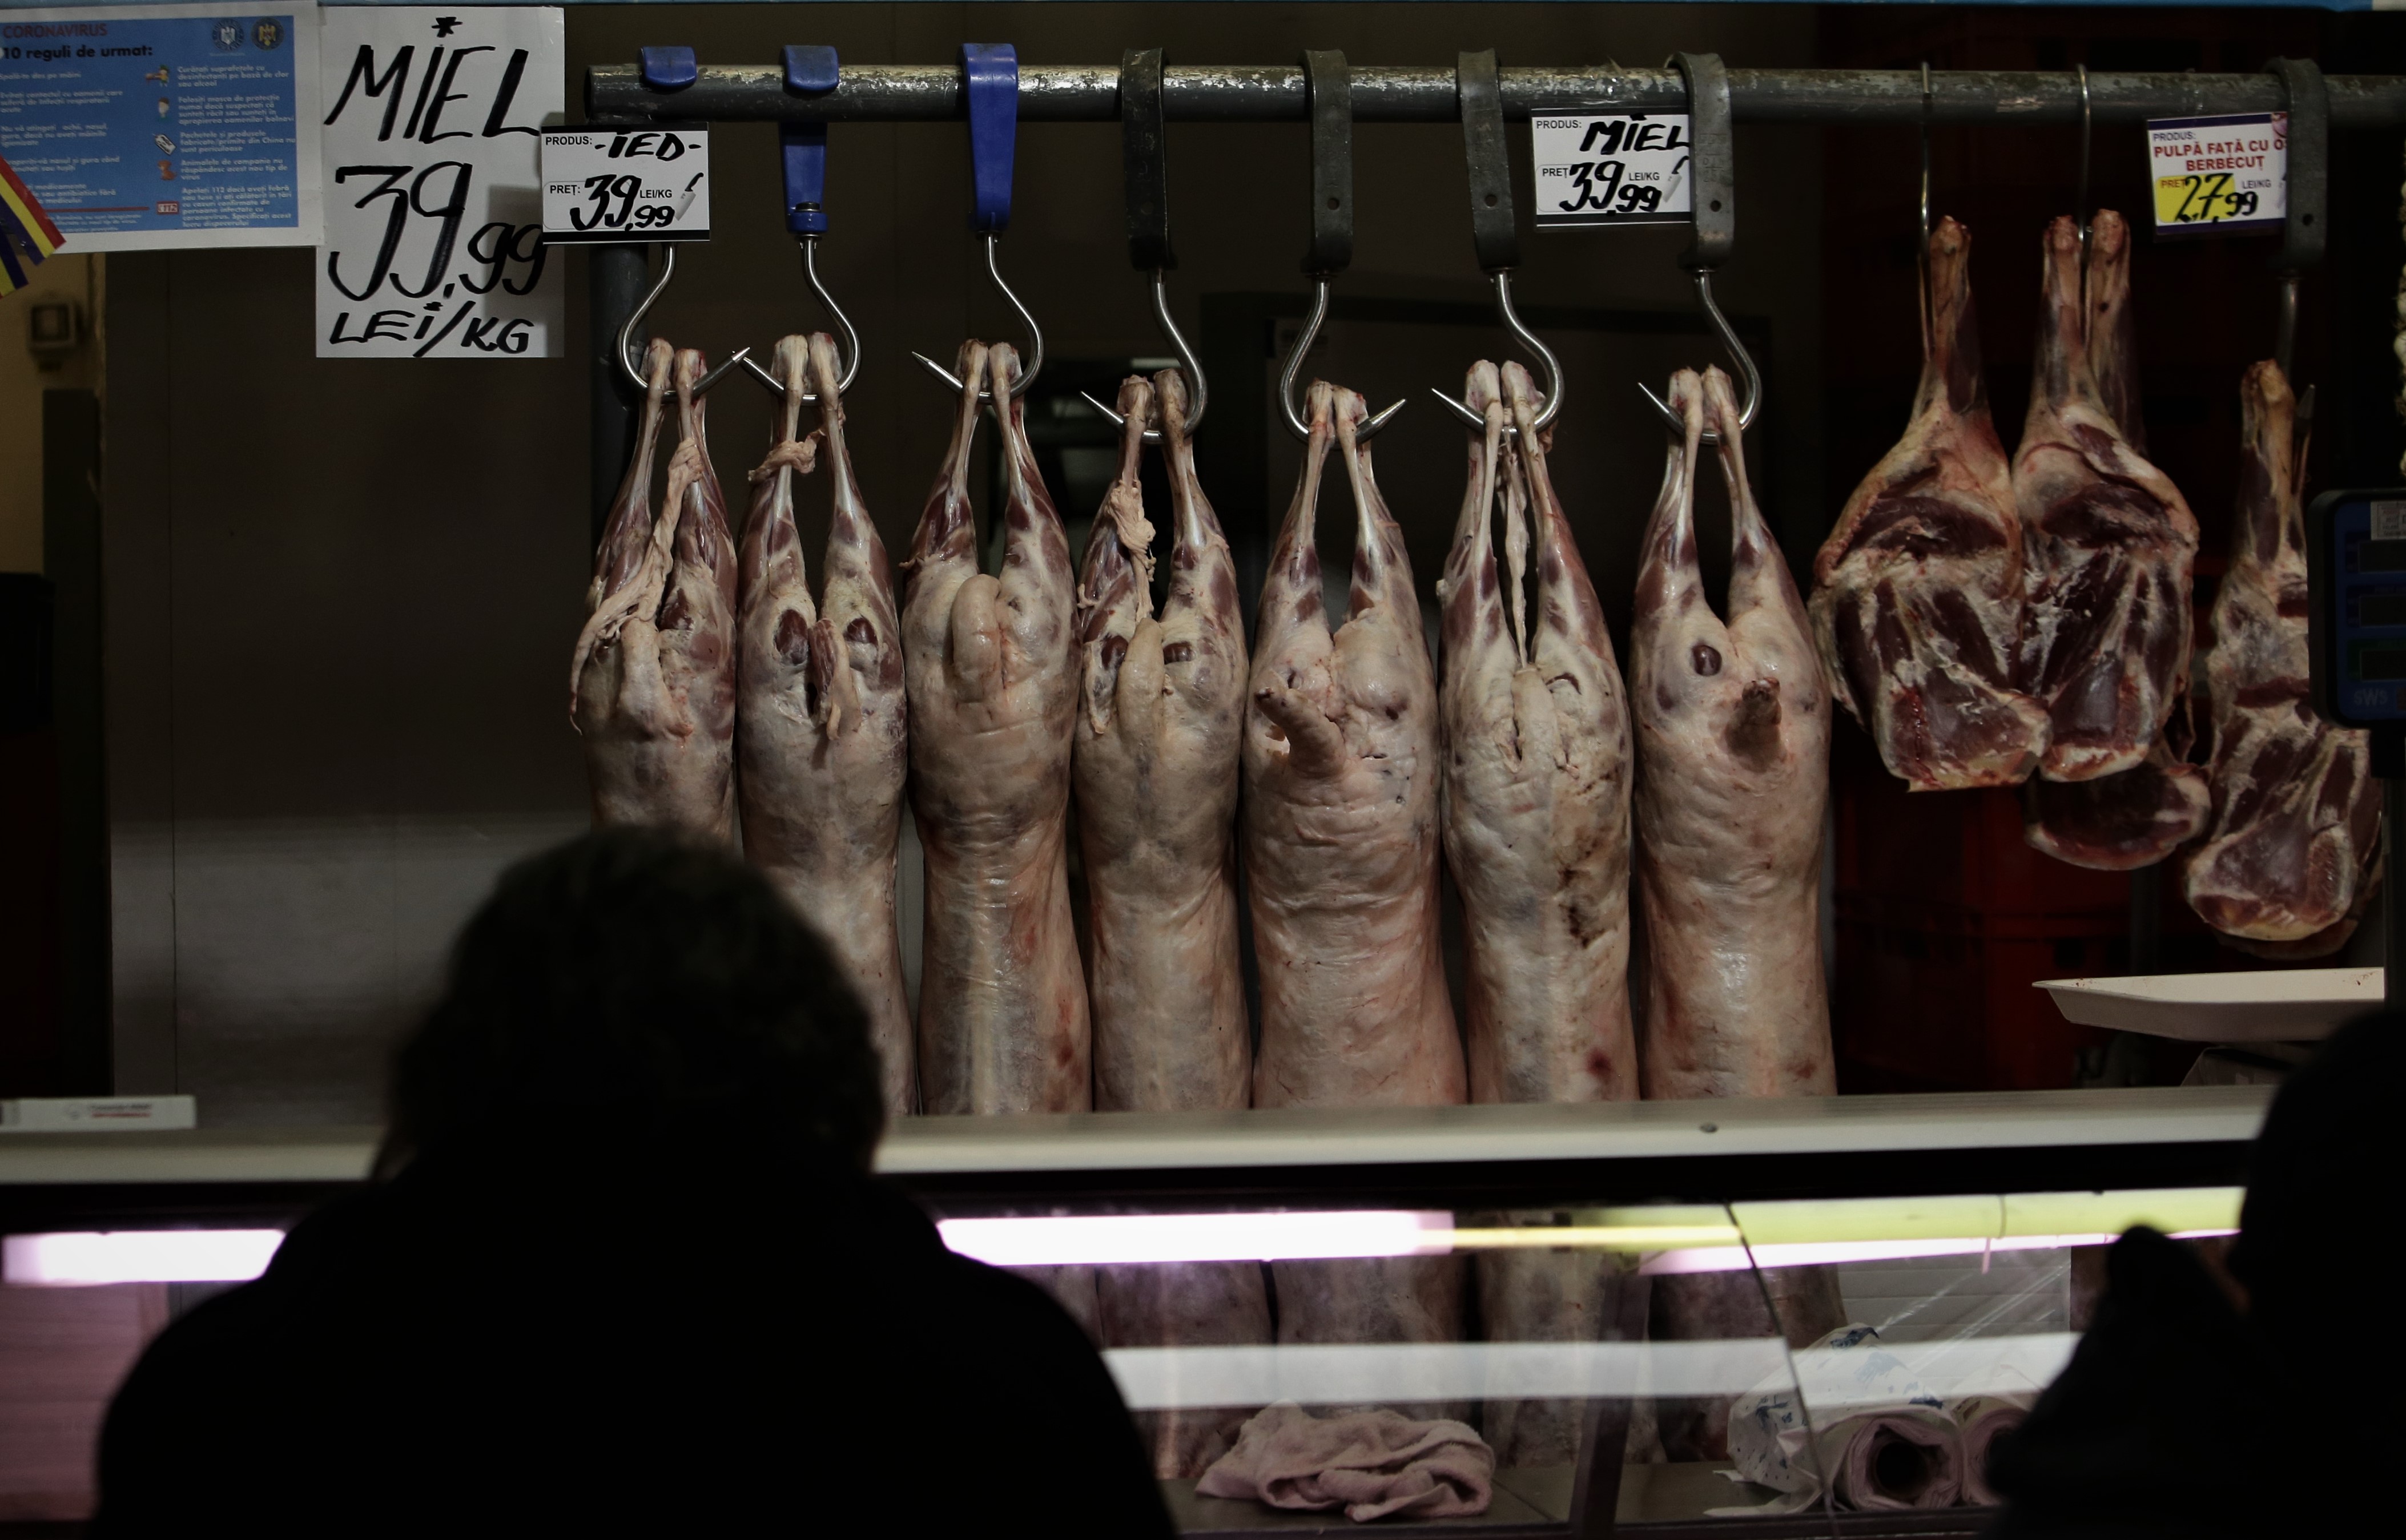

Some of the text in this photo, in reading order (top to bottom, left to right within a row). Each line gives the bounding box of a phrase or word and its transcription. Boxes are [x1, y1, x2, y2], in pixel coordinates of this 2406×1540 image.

[3, 23, 107, 39] CORONAVIRUS
[3, 44, 153, 62] 10 reguli de urmat:
[324, 17, 540, 144] MIEL
[545, 136, 593, 145] PRODUS:
[1536, 112, 1689, 155] PRODUS: MIEL
[2153, 131, 2196, 142] PRODUS:
[2154, 139, 2287, 158] PULPĂ FAȚĂ CU O
[2186, 156, 2265, 171] BERBECUȚ
[1559, 161, 1662, 216] 39,99
[1629, 172, 1660, 181] LEI/KG
[550, 174, 675, 231] PREȚ: 39,99 LEI/KG
[2175, 173, 2259, 224] 27,99
[2242, 179, 2272, 190] LEI/KG
[328, 161, 547, 301] 39,99
[2353, 688, 2388, 707] SWS
